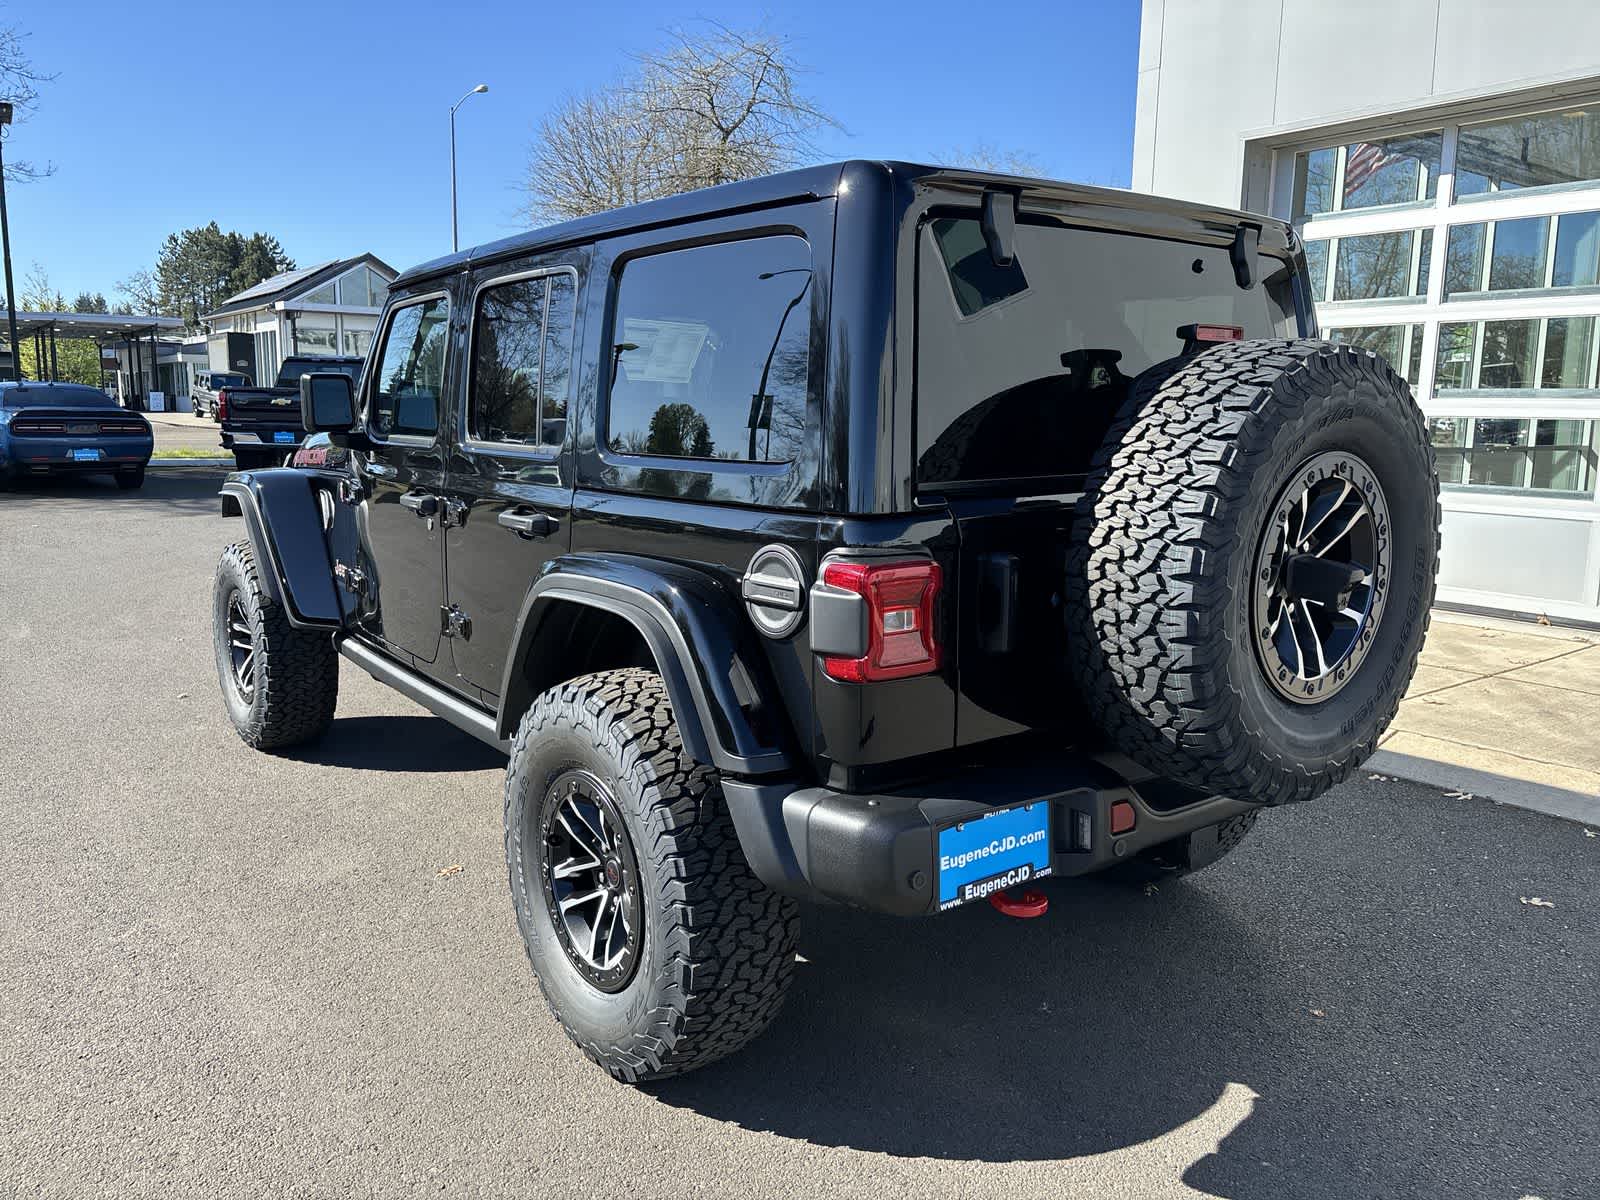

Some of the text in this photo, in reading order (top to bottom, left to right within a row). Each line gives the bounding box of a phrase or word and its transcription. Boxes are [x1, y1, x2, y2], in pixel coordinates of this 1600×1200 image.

[940, 830, 1045, 871] EugeneCJD.com
[940, 866, 1052, 911] www. EugeneCJD .com
